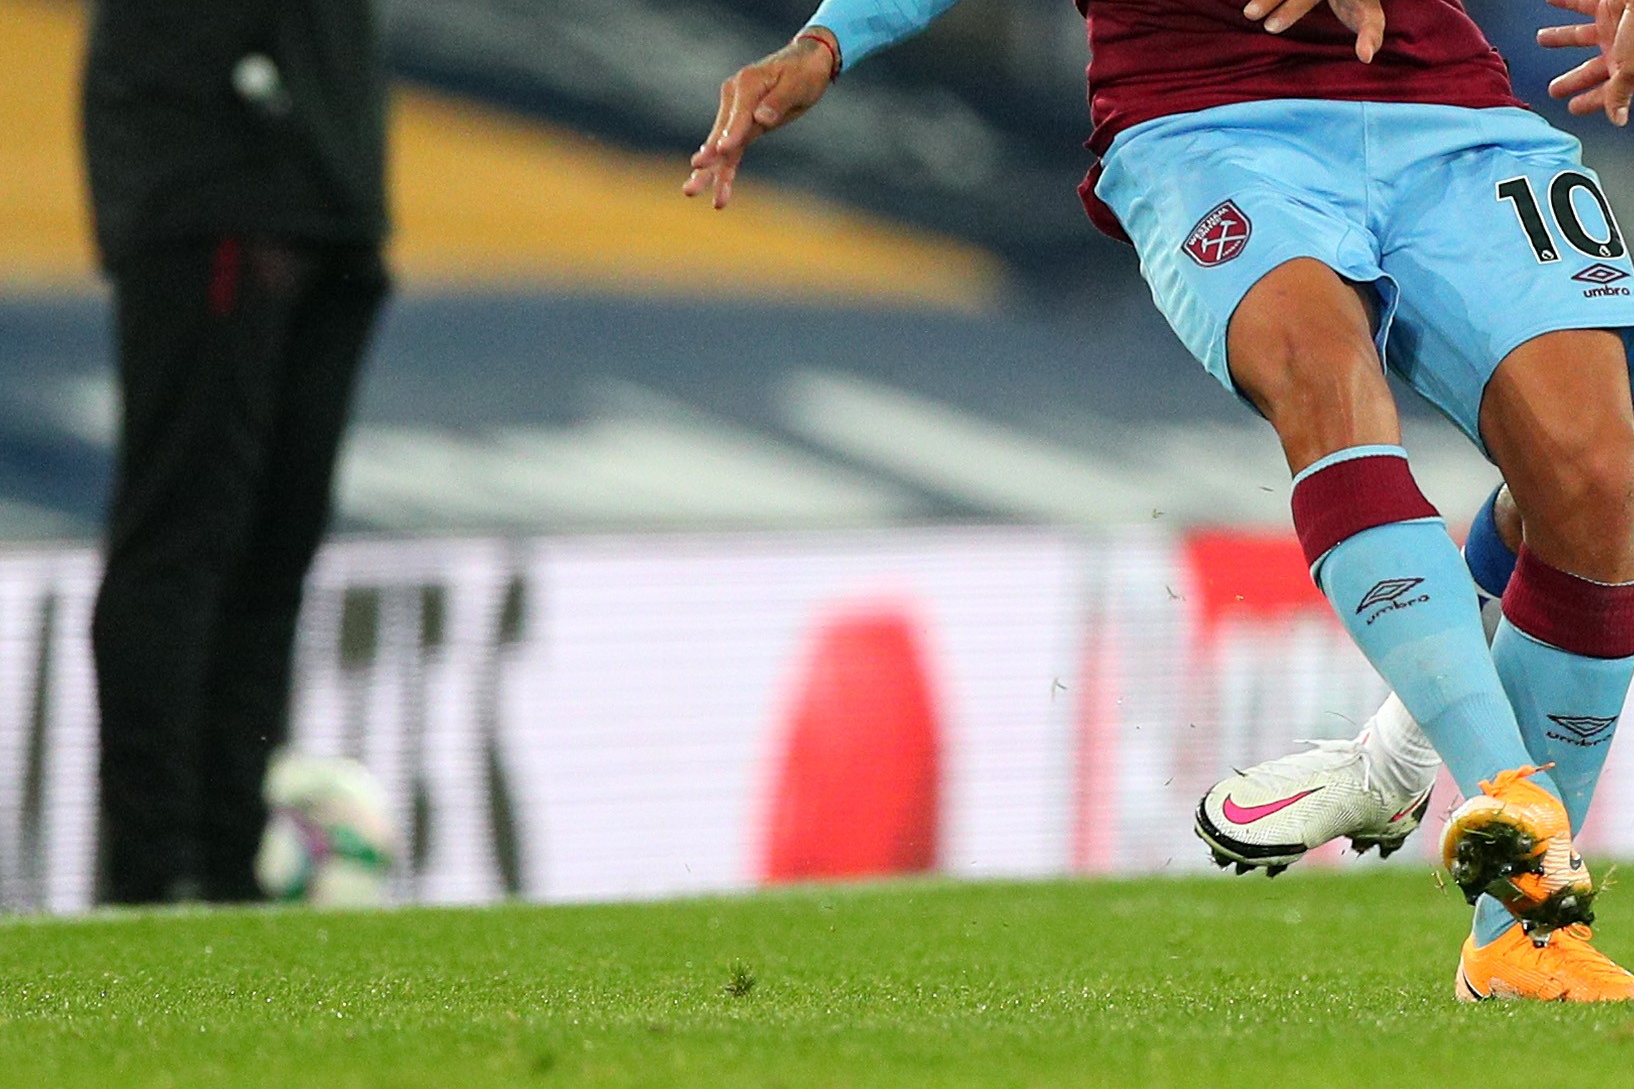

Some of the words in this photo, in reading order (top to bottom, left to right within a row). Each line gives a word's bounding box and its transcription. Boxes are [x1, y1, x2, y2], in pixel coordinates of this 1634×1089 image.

[1494, 169, 1627, 265] 10
[1582, 285, 1631, 299] umbro
[1366, 594, 1430, 626] umbro
